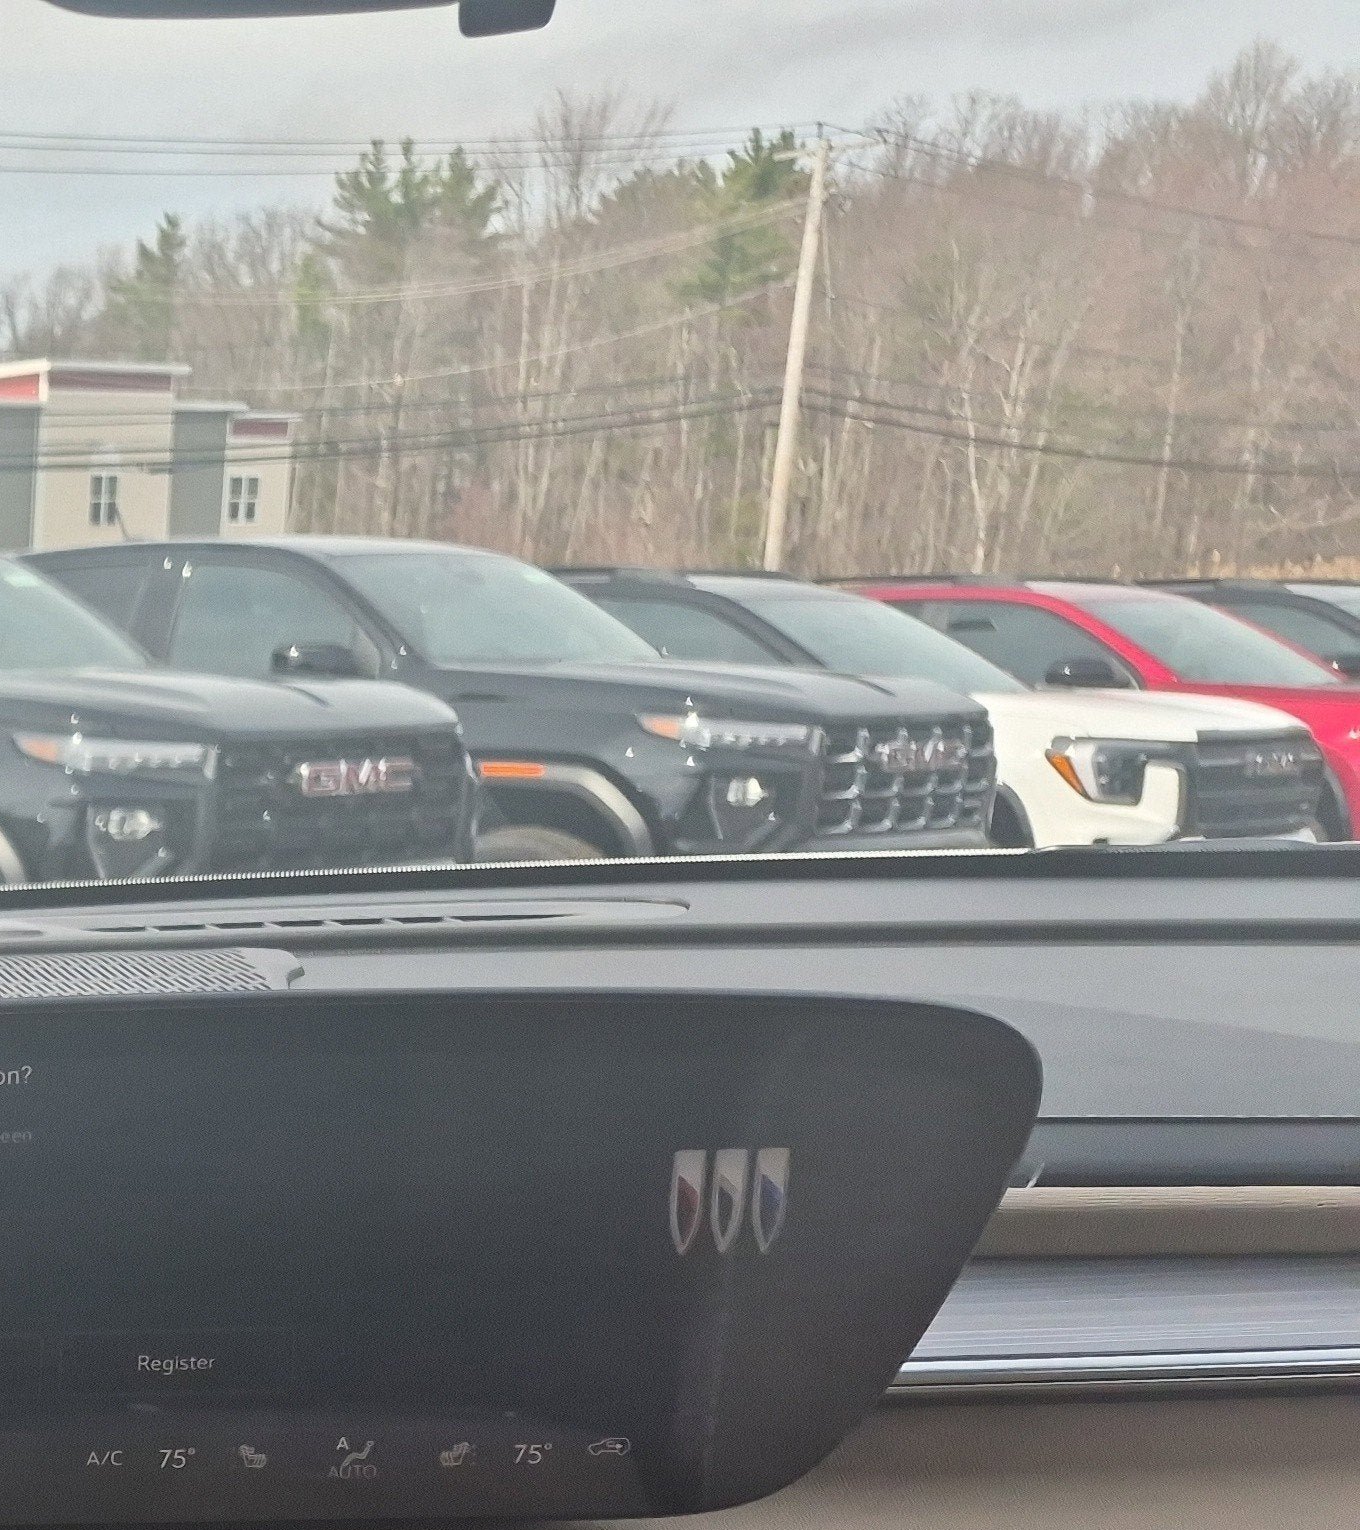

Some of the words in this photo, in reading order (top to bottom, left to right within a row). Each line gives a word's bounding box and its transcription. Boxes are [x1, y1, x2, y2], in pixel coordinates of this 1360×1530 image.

[297, 757, 416, 797] GMC
[137, 1354, 215, 1375] Register
[86, 1450, 123, 1468] A/C
[159, 1446, 196, 1469] 75°
[513, 1442, 554, 1465] 75°
[328, 1464, 378, 1480] AUTO
